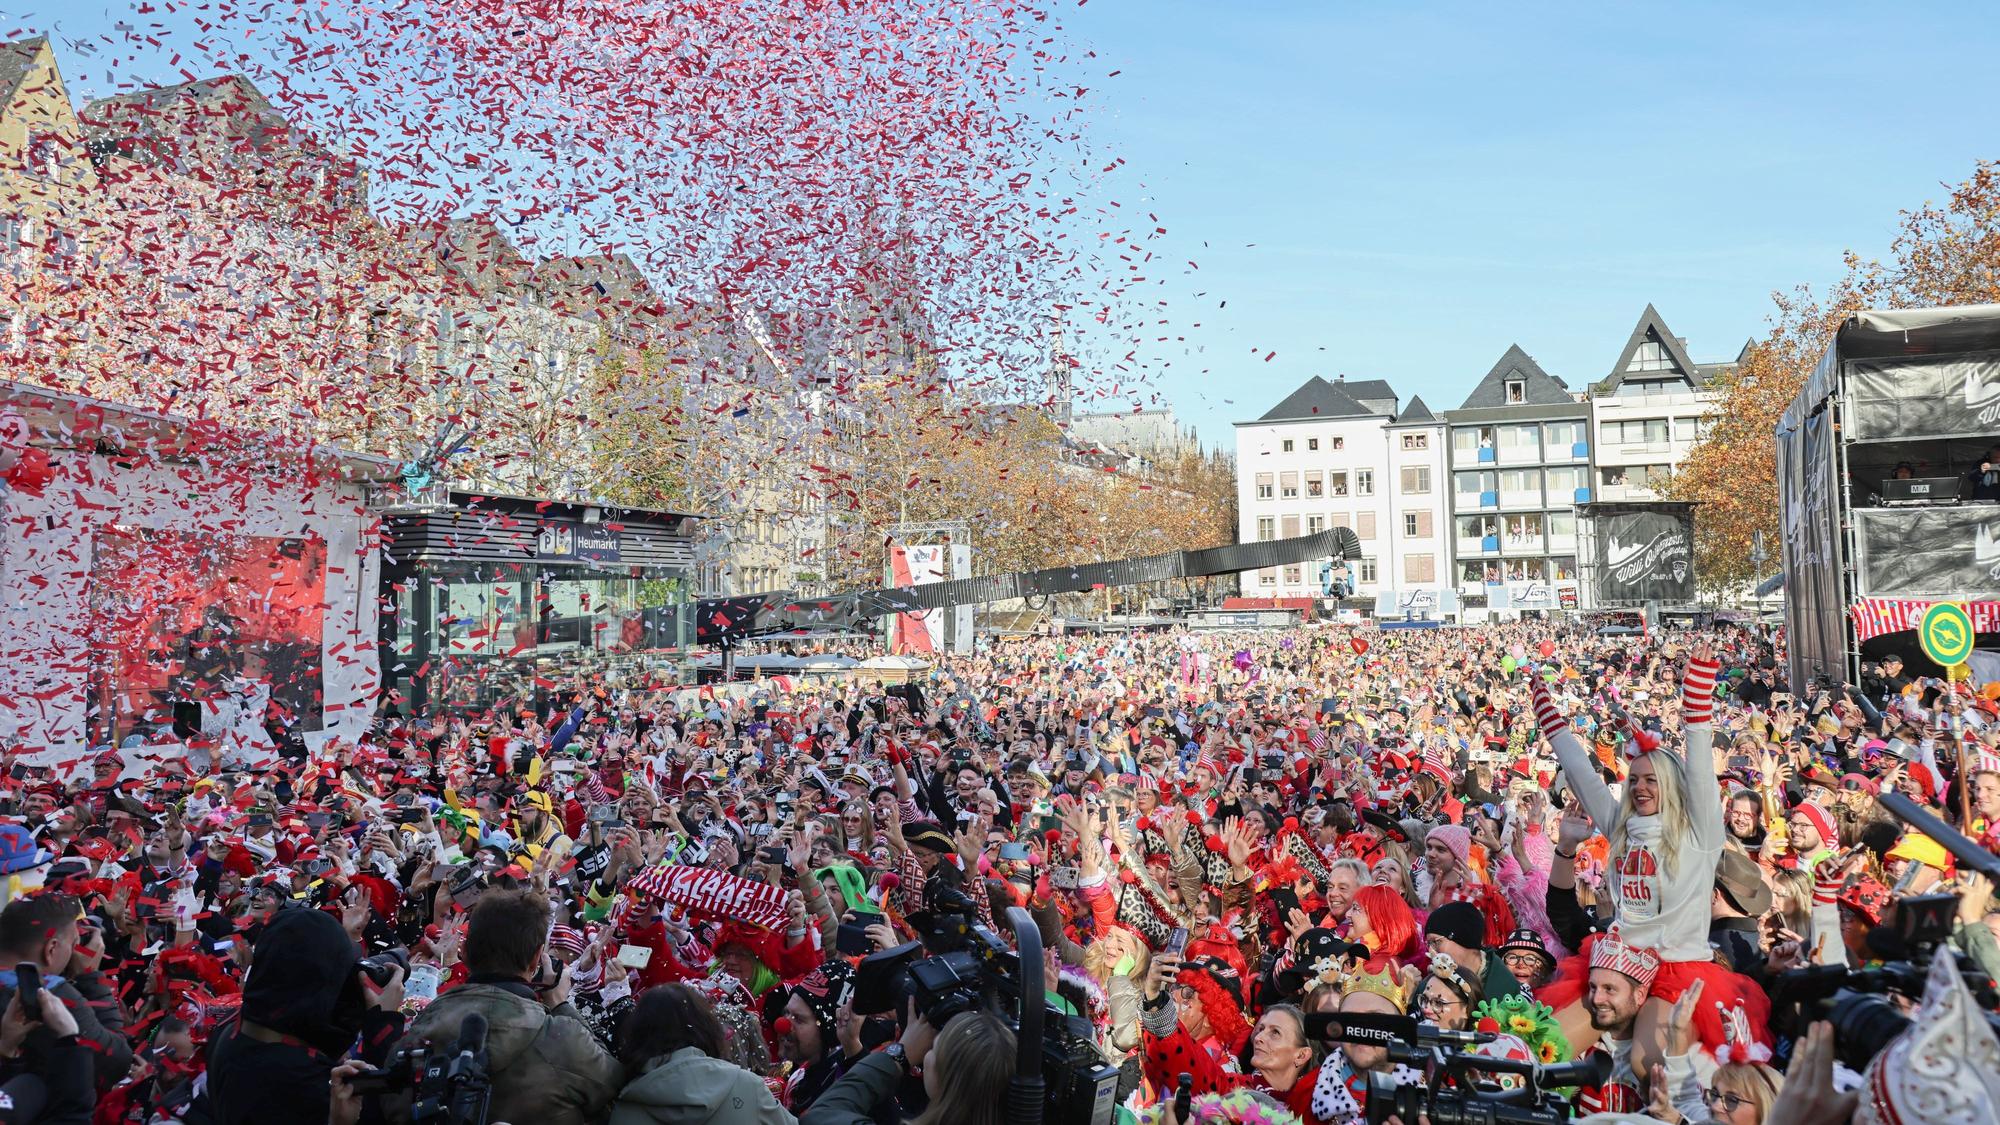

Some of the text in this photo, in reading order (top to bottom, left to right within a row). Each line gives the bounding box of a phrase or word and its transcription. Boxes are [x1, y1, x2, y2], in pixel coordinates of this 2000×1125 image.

[577, 536, 617, 550] Heumarkt
[1616, 558, 1643, 583] Willi
[1346, 1026, 1395, 1040] REUTERS
